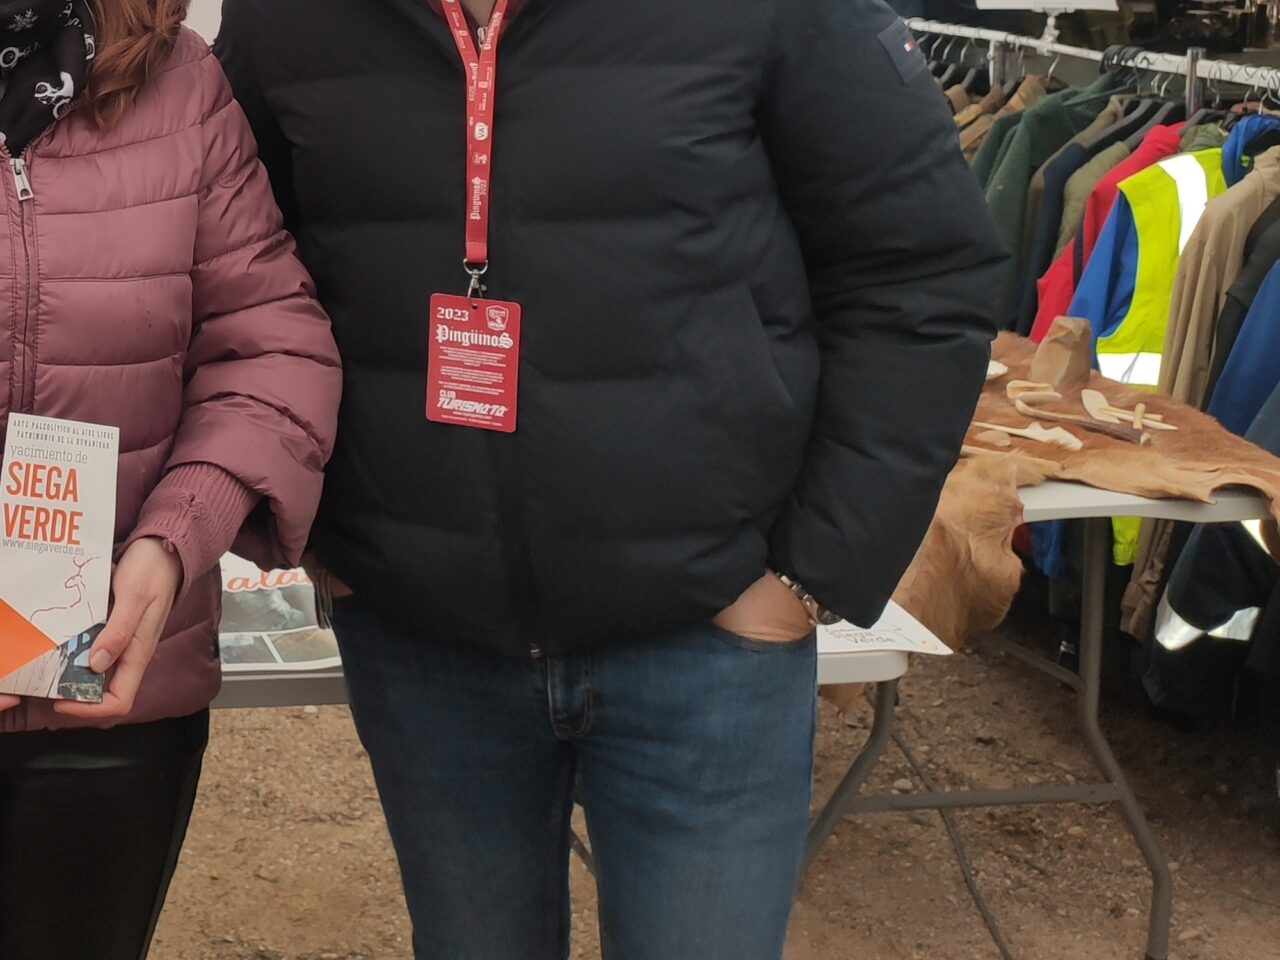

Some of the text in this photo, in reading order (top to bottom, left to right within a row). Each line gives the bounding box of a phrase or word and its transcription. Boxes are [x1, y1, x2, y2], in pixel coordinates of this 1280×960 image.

[437, 306, 469, 322] 2023
[10, 444, 88, 465] yacimiento de
[6, 460, 79, 503] SIEGA
[4, 502, 84, 546] VERDE
[2, 538, 86, 557] www.siegaverde.es
